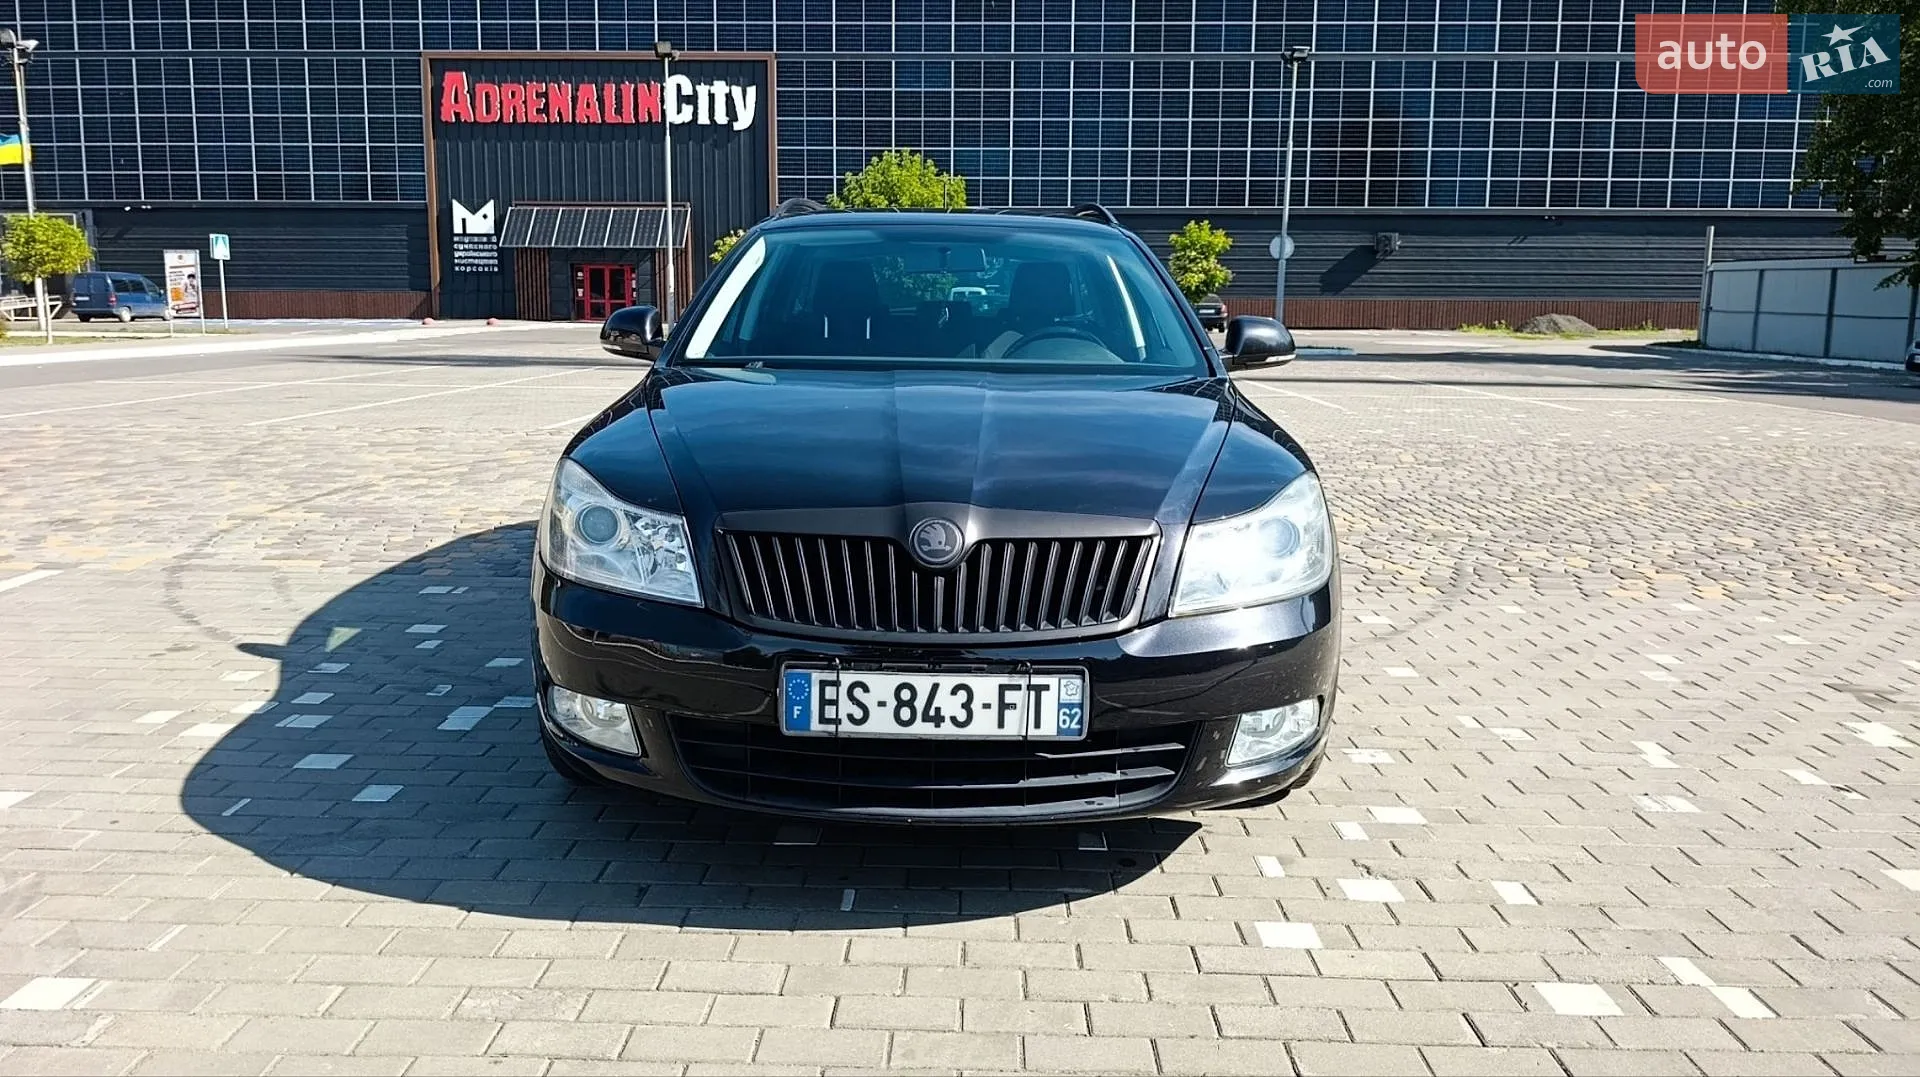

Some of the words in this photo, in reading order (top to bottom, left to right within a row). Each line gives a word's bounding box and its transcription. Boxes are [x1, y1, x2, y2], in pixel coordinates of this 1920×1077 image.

[793, 706, 802, 719] F
[817, 679, 1050, 729] ES-843-FT
[1059, 707, 1082, 729] 62
